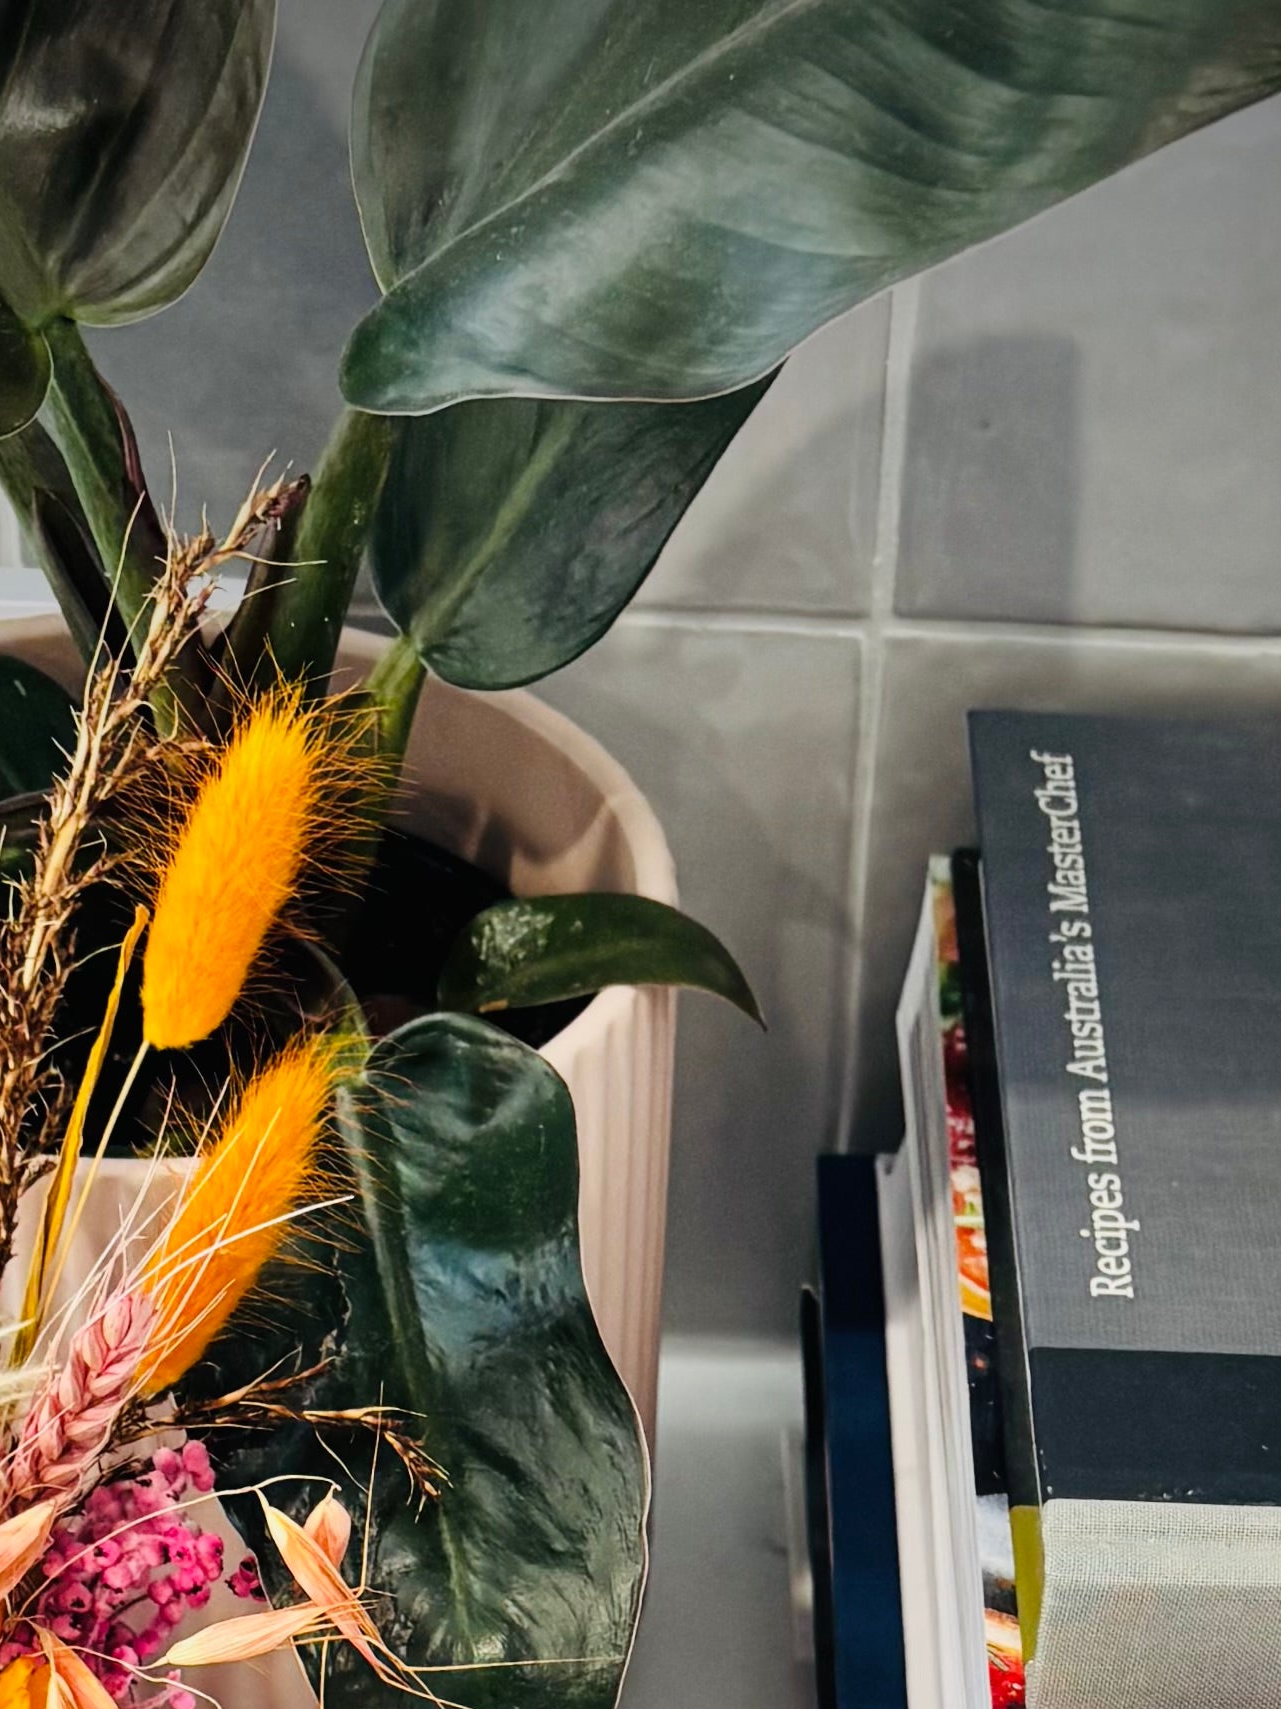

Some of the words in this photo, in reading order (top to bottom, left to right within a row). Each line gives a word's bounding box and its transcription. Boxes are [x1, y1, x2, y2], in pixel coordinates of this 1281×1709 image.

[1030, 749, 1089, 914] MasterChef
[1049, 920, 1108, 1084] Australia's
[1071, 1080, 1117, 1167] from
[1079, 1168, 1139, 1300] Recipes
